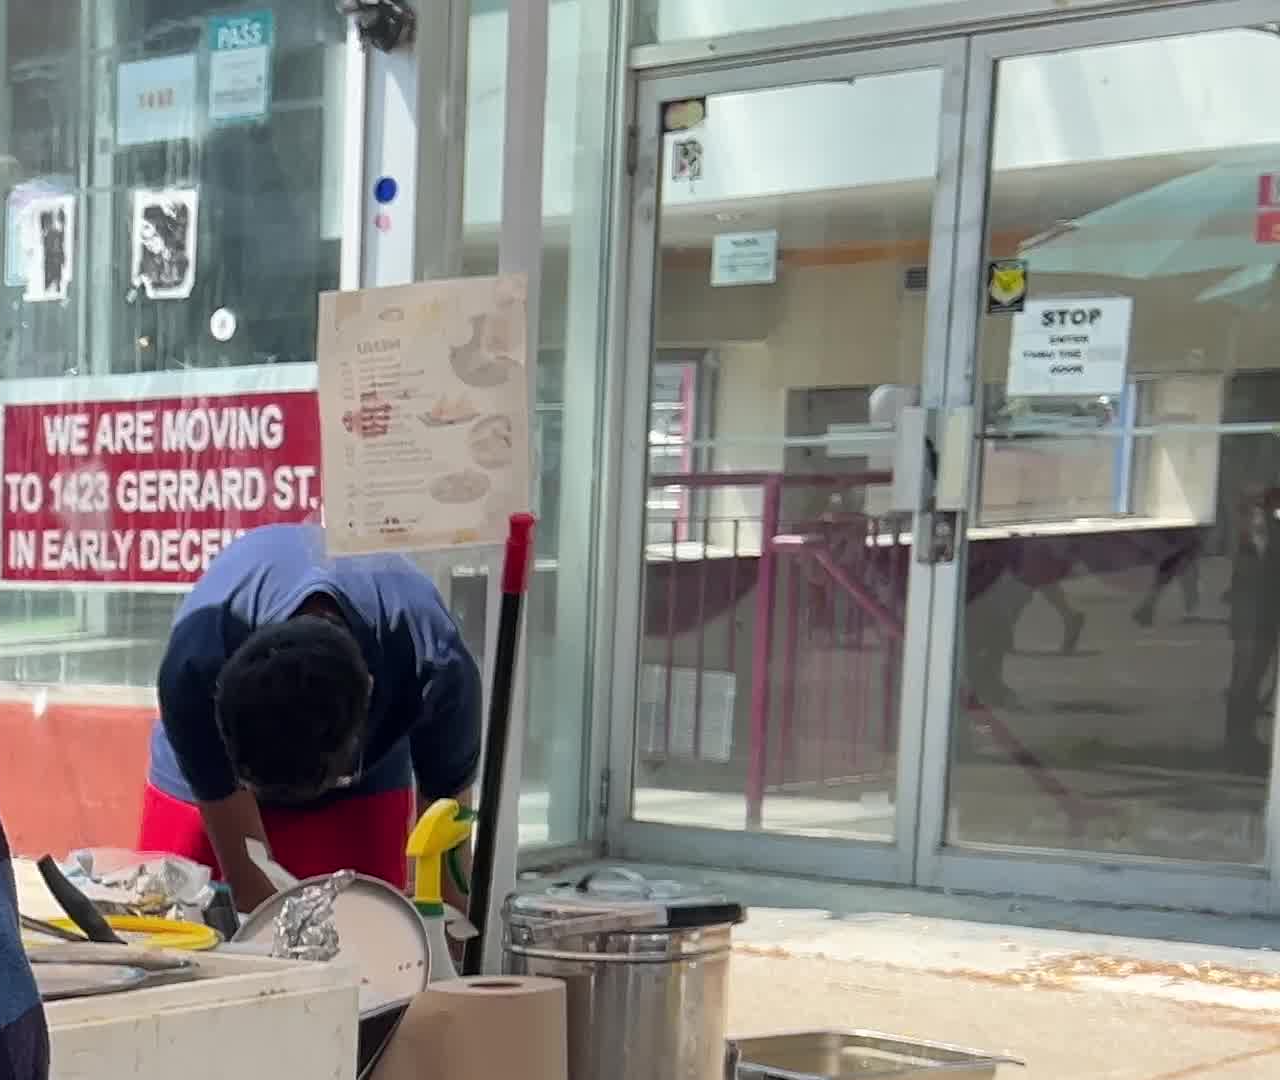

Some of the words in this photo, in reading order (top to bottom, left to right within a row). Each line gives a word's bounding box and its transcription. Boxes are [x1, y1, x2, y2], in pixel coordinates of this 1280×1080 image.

[217, 21, 264, 48] PASS
[1042, 308, 1103, 327] STOP
[43, 415, 89, 456] WE
[94, 410, 155, 455] ARE
[161, 404, 284, 453] MOVING
[4, 472, 43, 513] TO
[48, 470, 111, 512] 1423
[116, 467, 267, 513] GERRARD
[272, 464, 321, 511] ST.
[7, 530, 36, 571] IN
[42, 530, 135, 571] EARLY
